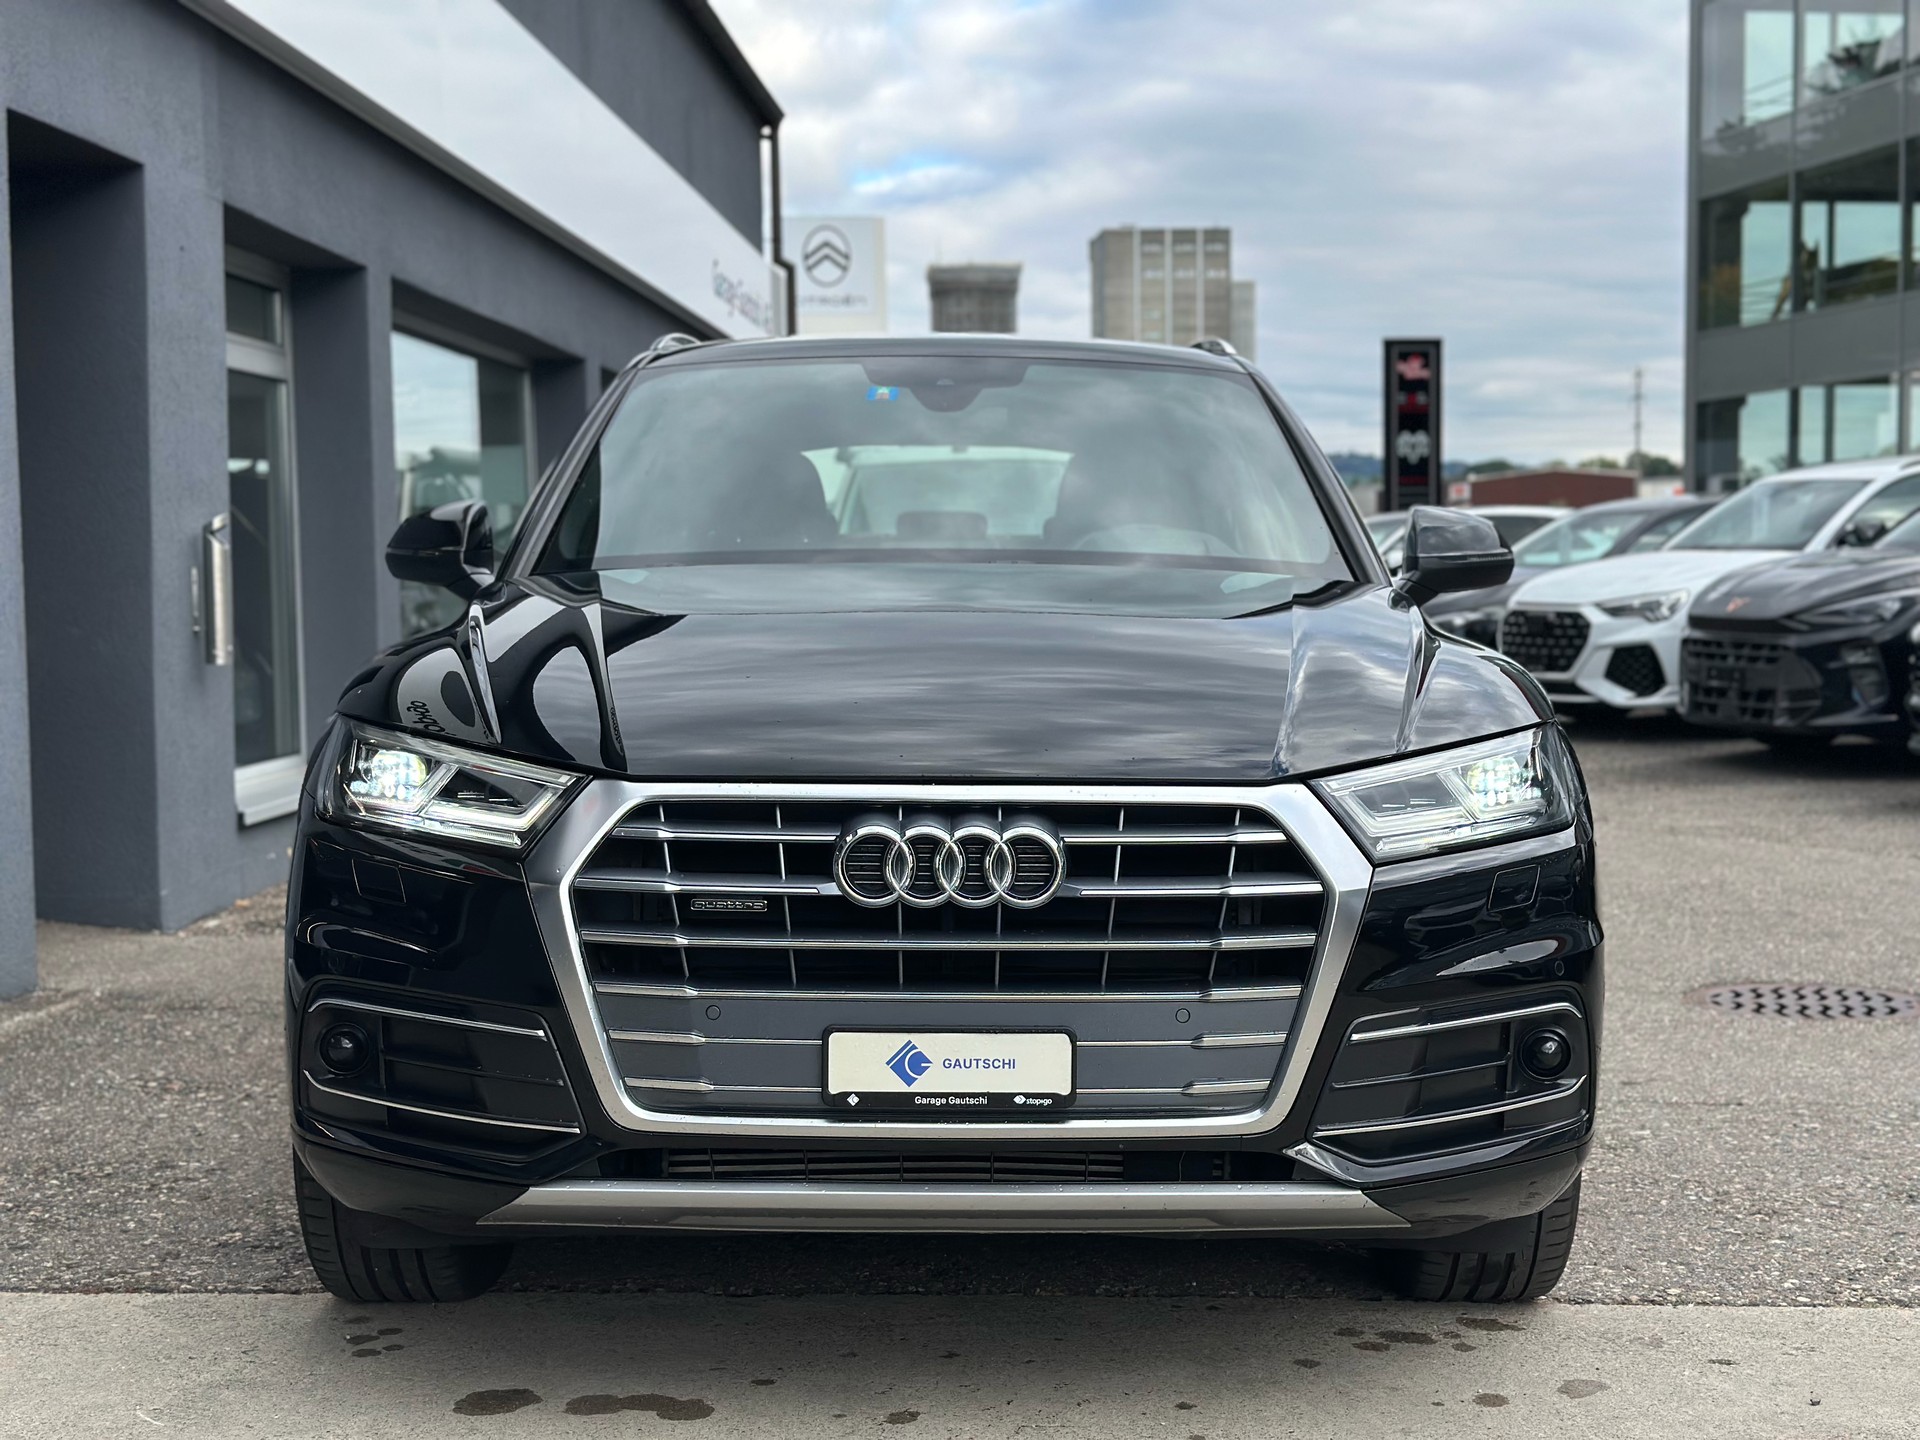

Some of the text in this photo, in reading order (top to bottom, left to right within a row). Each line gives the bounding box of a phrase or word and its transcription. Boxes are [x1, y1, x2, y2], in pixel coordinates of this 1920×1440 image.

[693, 900, 765, 910] quattro
[943, 1058, 1016, 1070] GAUTSCHI
[914, 1095, 988, 1106] Garage Gautschi
